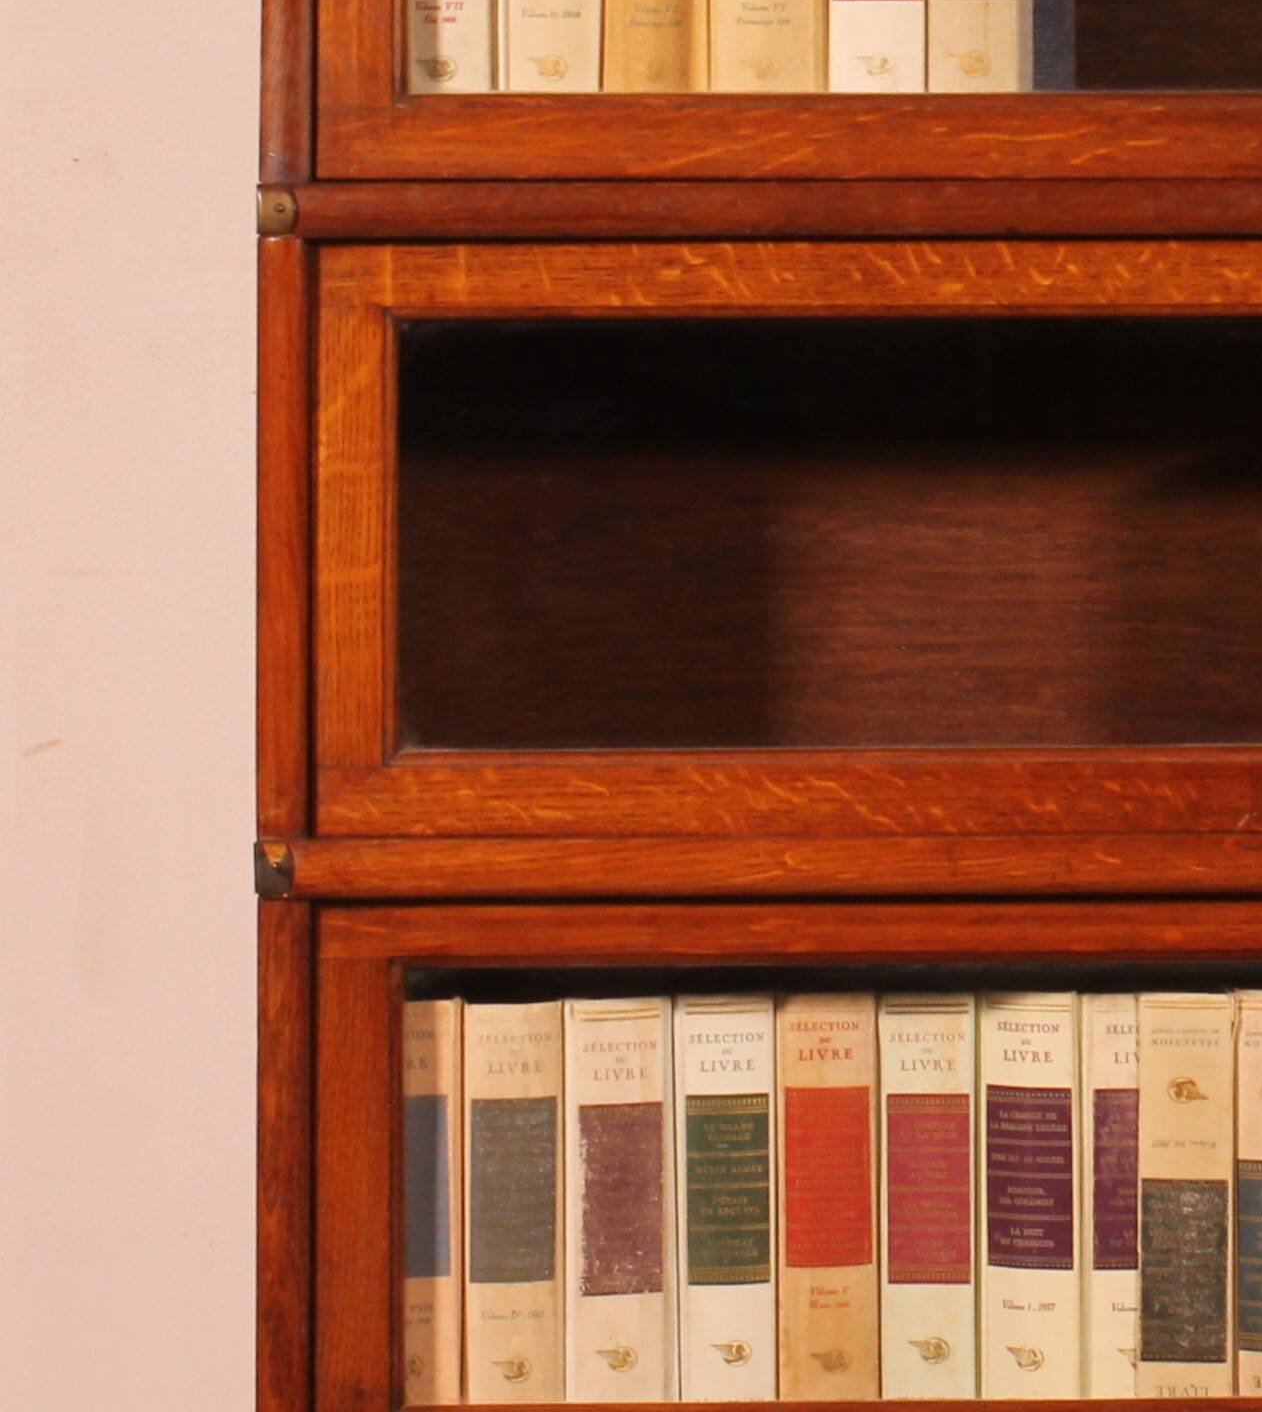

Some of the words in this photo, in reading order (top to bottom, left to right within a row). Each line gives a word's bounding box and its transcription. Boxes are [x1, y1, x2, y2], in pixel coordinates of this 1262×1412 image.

[798, 1048, 854, 1061] LIVRE
[1003, 1050, 1054, 1063] LIVRE
[488, 1060, 542, 1075] LIVRE
[700, 1059, 755, 1073] LIVRE
[900, 1059, 957, 1072] LIVRE
[593, 1067, 648, 1082] LIVRE
